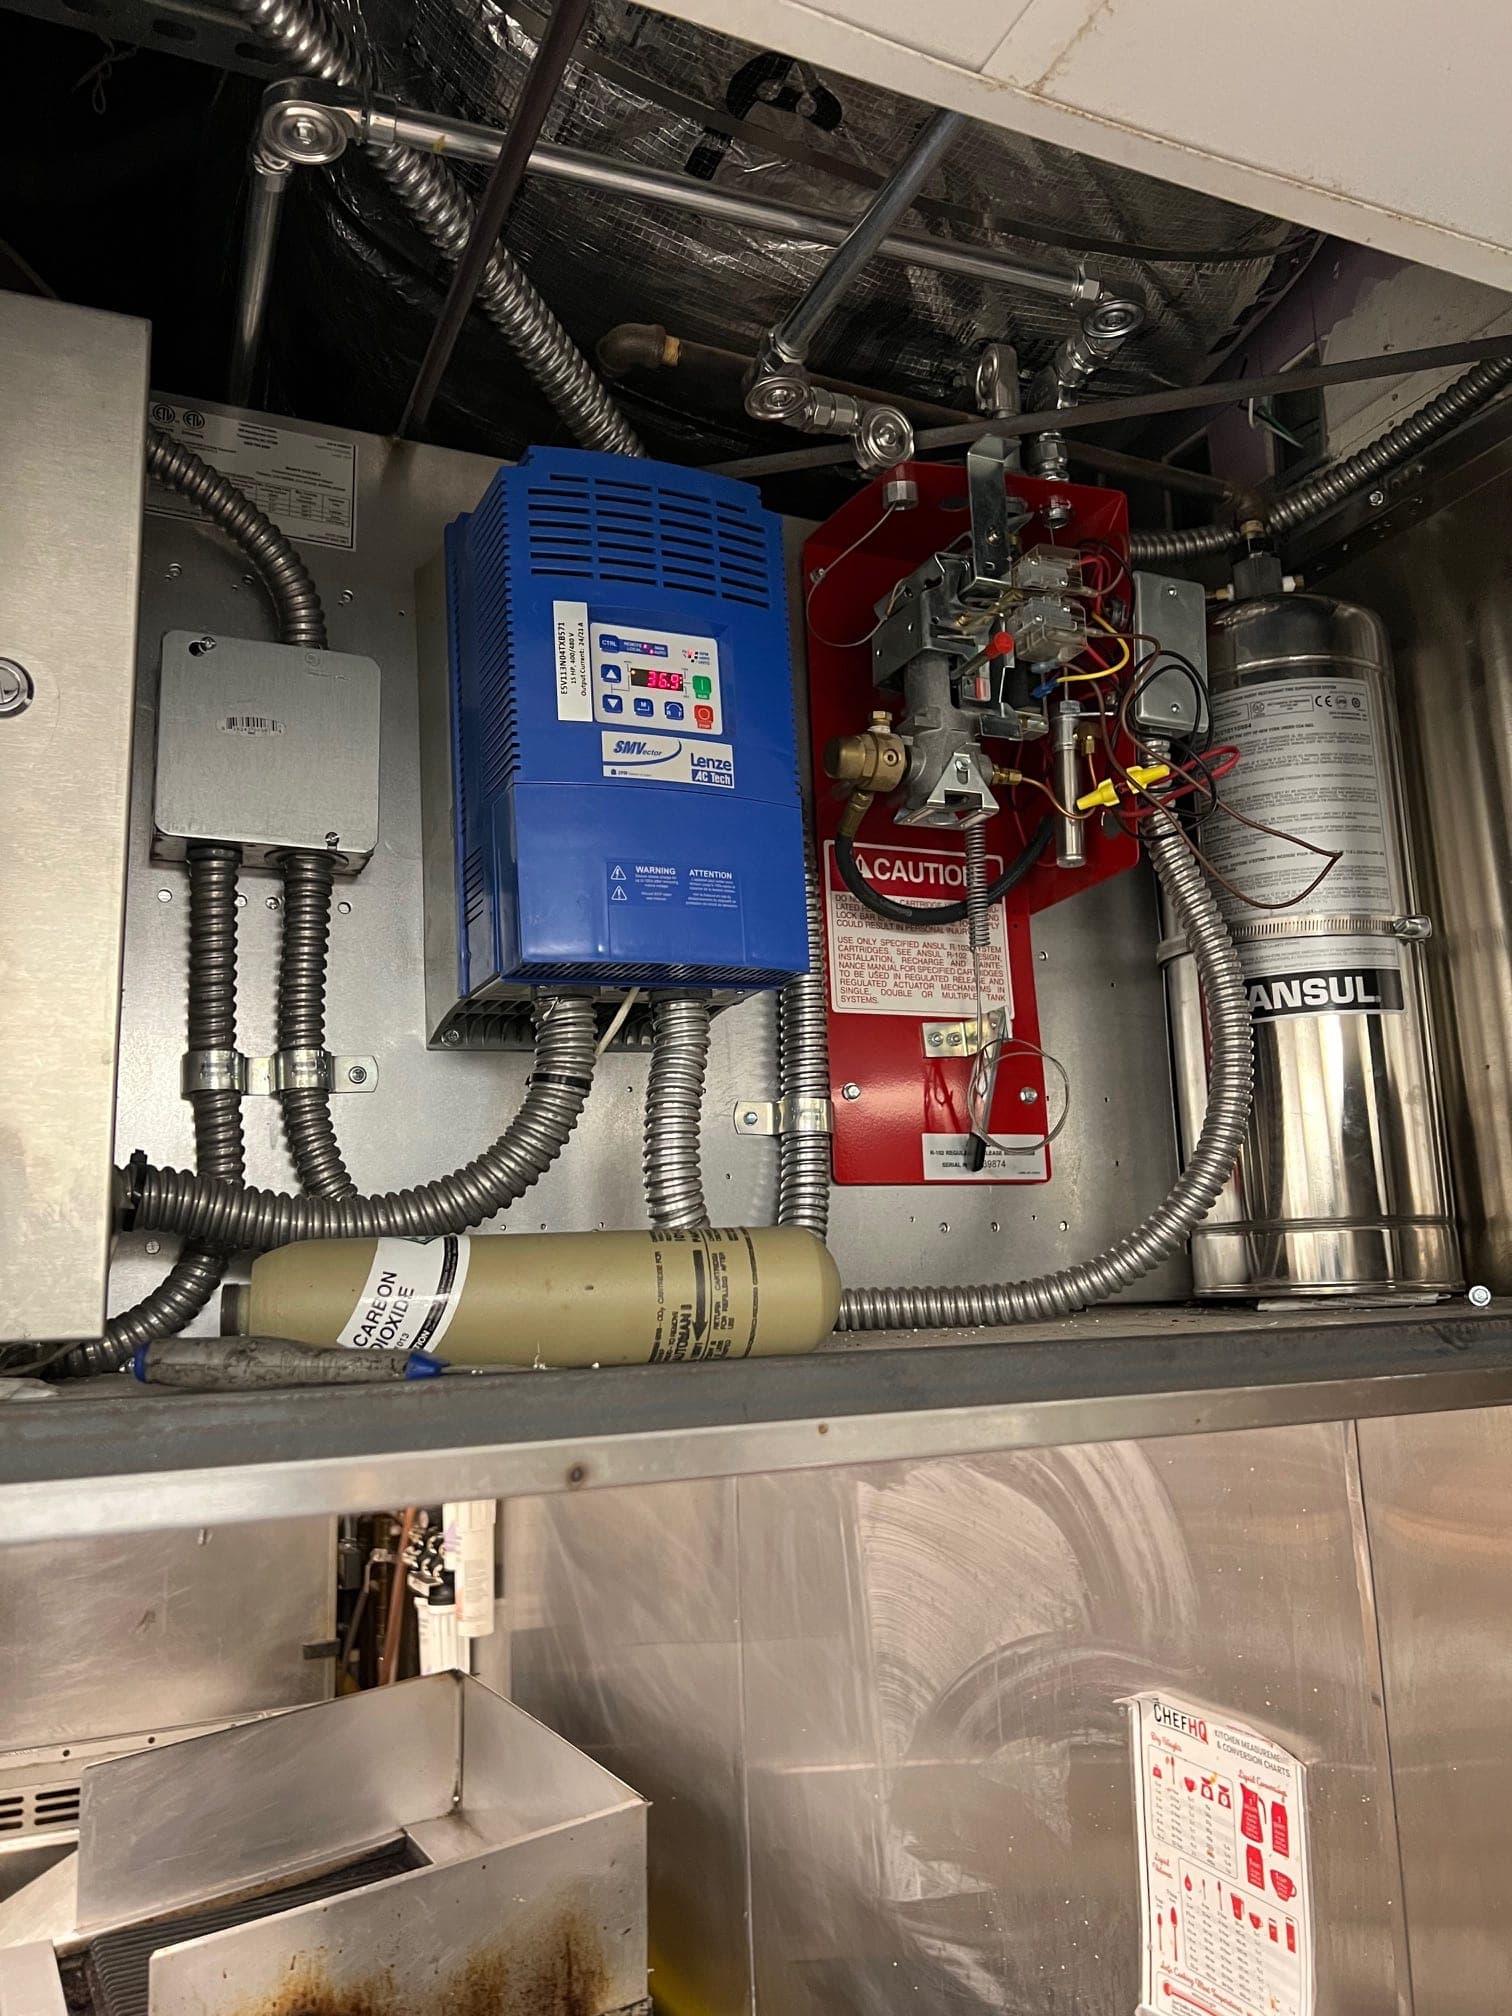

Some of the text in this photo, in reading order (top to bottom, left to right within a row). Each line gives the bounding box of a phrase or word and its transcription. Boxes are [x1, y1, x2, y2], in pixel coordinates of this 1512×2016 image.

[601, 639, 617, 647] CTRL
[580, 674, 588, 697] Output
[647, 671, 679, 689] 36.9
[1314, 695, 1333, 708] CE
[613, 740, 662, 756] SMVector
[690, 752, 732, 772] Lenze
[695, 771, 731, 785] AC Tech
[635, 865, 676, 875] WARNING
[689, 868, 733, 880] ATTENTION
[835, 894, 847, 902] DO
[836, 911, 857, 919] LOCK
[836, 919, 863, 928] COULD
[865, 921, 893, 930] RESULT
[947, 926, 969, 934] INJUR
[837, 936, 853, 944] USE
[857, 937, 877, 945] ONLY
[880, 938, 919, 948] SPECIFIED
[922, 941, 947, 951] ANSUL
[975, 945, 1001, 953] YSTEM
[896, 948, 911, 956] SEE
[917, 949, 941, 958] ANSUL
[977, 953, 1001, 961] ESIGN,
[901, 956, 944, 967] RECHARGE
[839, 961, 1004, 977] NANCE MANUAL FOR SPECIFIED CARTIDGES
[839, 969, 850, 978] TO
[853, 970, 864, 978] BE
[868, 970, 889, 980] USED
[905, 973, 948, 983] REGULATED
[952, 975, 985, 984] RELEAE
[989, 977, 1004, 985] AND
[840, 978, 887, 988] REGULATED
[893, 980, 934, 990] ACTUATOR
[997, 985, 1005, 993] IN
[880, 988, 912, 998] DOUBLE
[921, 990, 933, 998] OR
[941, 991, 978, 1000] MULTIPLE
[986, 993, 1006, 1001] TANK
[1250, 976, 1377, 1011] ANSUL
[1153, 1703, 1209, 1744] CHEFHQ
[1214, 1729, 1241, 1748] KITCHEN
[1222, 1743, 1263, 1767] CONVERSION
[1263, 1762, 1291, 1778] CHARTS
